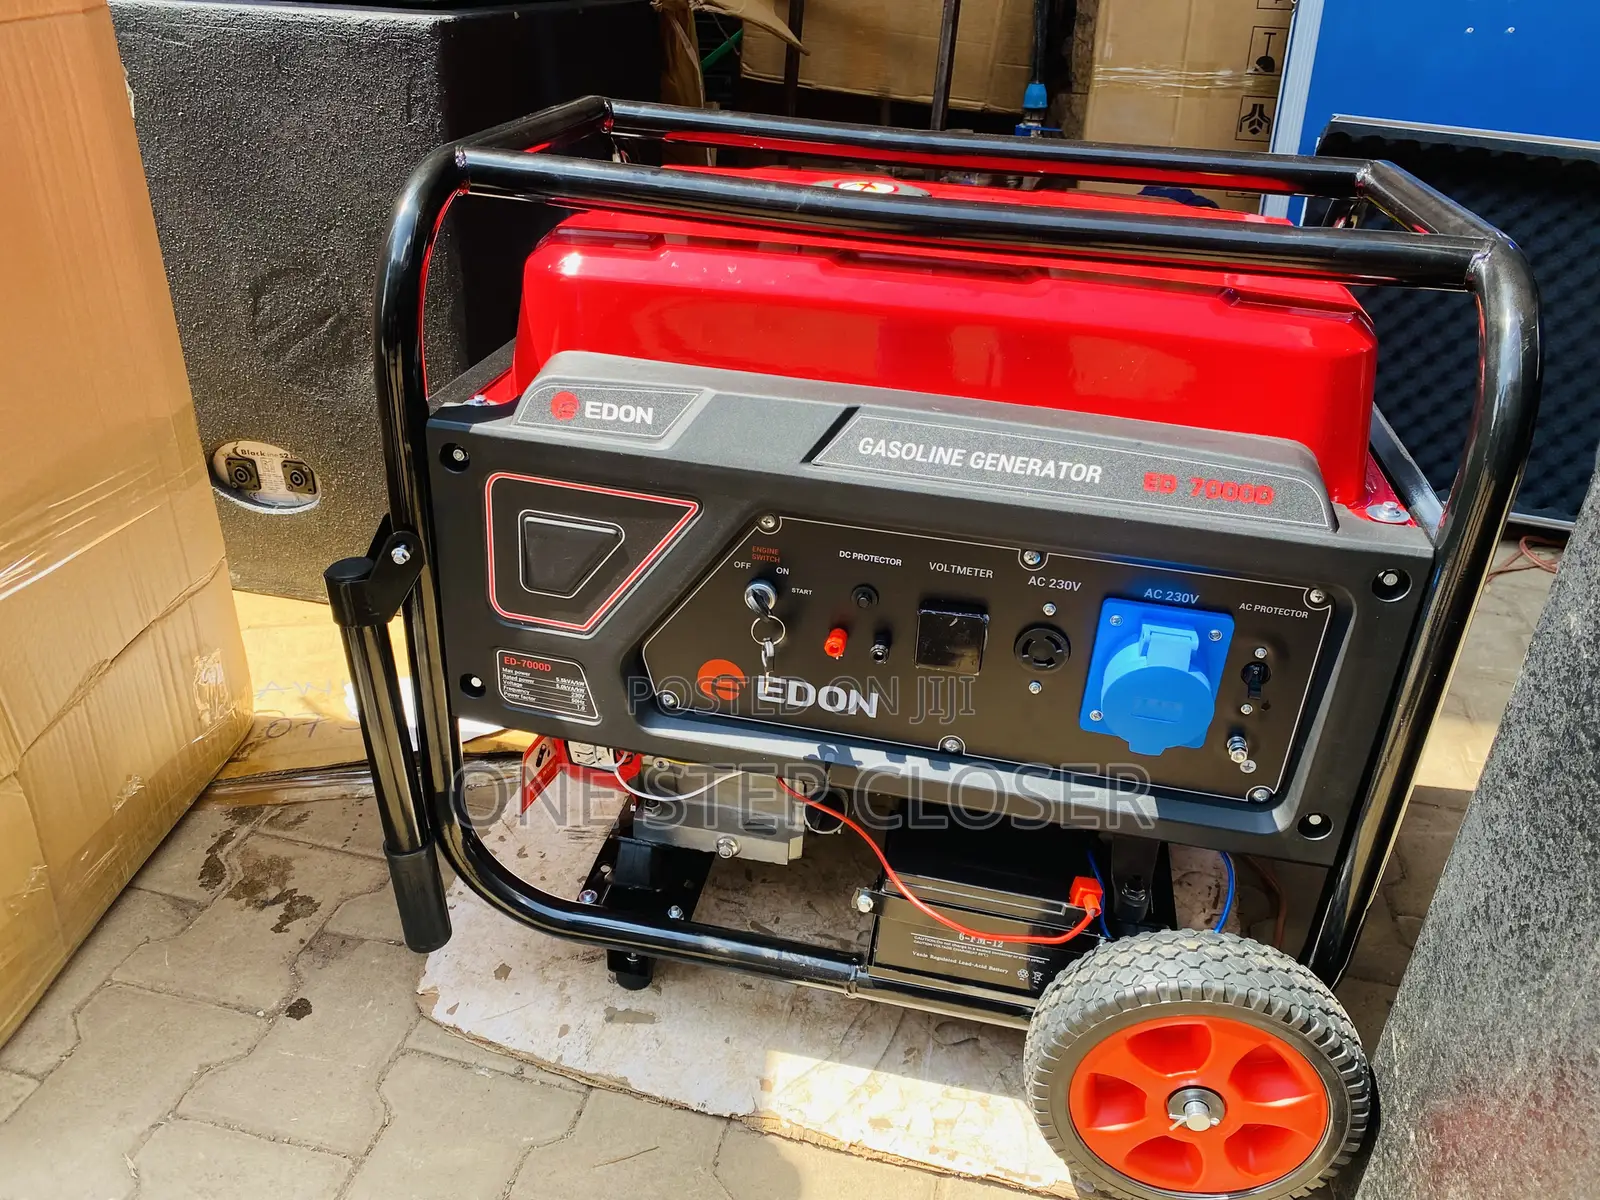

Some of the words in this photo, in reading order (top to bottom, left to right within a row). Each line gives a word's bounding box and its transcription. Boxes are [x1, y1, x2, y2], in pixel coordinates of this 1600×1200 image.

[584, 400, 654, 425] EDON
[857, 436, 967, 468] GASOLINE
[969, 449, 1102, 485] GENERATOR
[1143, 472, 1178, 494] ED
[1189, 476, 1275, 506] 7000D
[752, 545, 779, 555] ENGINE
[752, 553, 780, 563] SWITCH
[839, 550, 851, 559] DC
[852, 552, 902, 567] PROTECTOR
[733, 561, 751, 570] OFF
[776, 567, 790, 576] ON
[929, 561, 994, 579] VOLTMETER
[1028, 575, 1046, 587] AC
[1048, 578, 1082, 592] 230V
[791, 587, 813, 596] START
[1144, 588, 1163, 600] AC
[1165, 591, 1200, 605] 230V
[1239, 602, 1253, 611] AC
[1254, 604, 1309, 619] PROTECTOR
[503, 657, 551, 671] ED-7000D
[502, 667, 514, 675] Max
[514, 669, 531, 677] power
[503, 674, 518, 682] Rated
[519, 677, 535, 685] power
[503, 680, 523, 688] Voltage
[503, 686, 530, 695] Frequency
[504, 691, 520, 699] Power
[520, 694, 536, 702] factor
[757, 674, 879, 719] EDON
[930, 954, 957, 963] Regulated
[958, 960, 988, 970] Lead-Acid
[988, 965, 1009, 975] Battery
